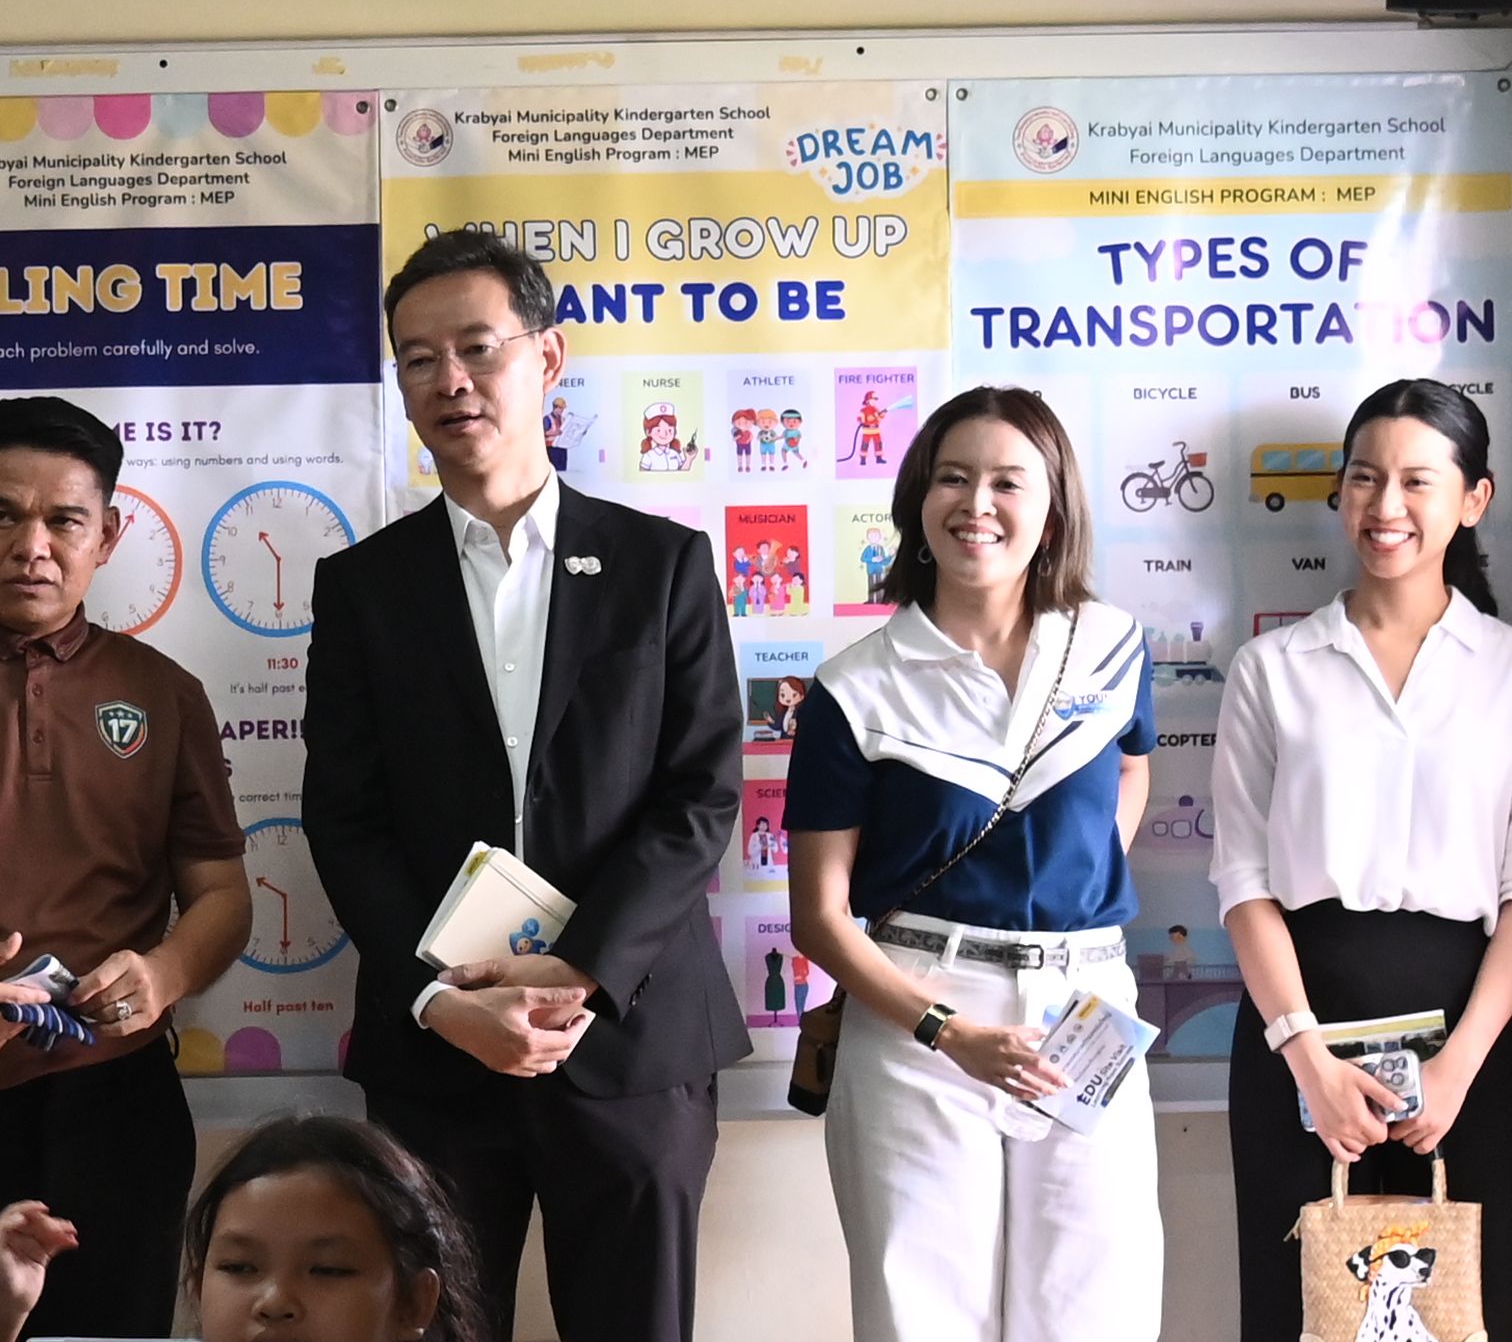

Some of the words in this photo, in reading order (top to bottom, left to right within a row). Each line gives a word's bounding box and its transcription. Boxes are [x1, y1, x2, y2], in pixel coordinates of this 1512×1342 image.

[455, 111, 511, 129] Krabyai
[517, 110, 609, 124] Municipality
[614, 109, 713, 123] Kindergarten
[720, 107, 769, 119] School
[492, 130, 549, 145] Foreign
[554, 130, 636, 144] Languages
[642, 128, 733, 142] Department
[1089, 123, 1152, 138] Krabyai
[1159, 121, 1262, 138] Municipality
[1269, 120, 1381, 137] Kindergarten
[1388, 117, 1445, 133] School
[798, 127, 934, 163] DREAM
[33, 155, 124, 169] Municipality
[131, 153, 230, 168] Kindergarten
[236, 152, 286, 164] School
[509, 149, 539, 161] Mini
[545, 148, 600, 164] English
[606, 148, 670, 162] Program
[685, 146, 718, 158] MEP
[1130, 149, 1193, 165] Foreign
[1200, 150, 1294, 166] Languages
[1301, 147, 1404, 163] Department
[9, 175, 65, 191] Foreign
[70, 175, 152, 189] Languages
[158, 172, 249, 186] Department
[831, 161, 904, 195] JOB
[24, 194, 55, 207] Mini
[61, 194, 116, 209] English
[122, 193, 186, 207] Program
[201, 191, 234, 204] MEP
[1089, 190, 1130, 205] MINI
[1136, 189, 1214, 204] ENGLISH
[1221, 188, 1315, 202] PROGRAM
[1337, 187, 1375, 201] MEP
[425, 219, 596, 263] HEN
[616, 219, 630, 261] I
[645, 216, 818, 261] GROW
[832, 214, 908, 258] UP
[1097, 237, 1269, 284] TYPES
[1290, 239, 1369, 281] OF
[156, 262, 304, 312] TIME
[556, 283, 664, 324] ANT
[681, 282, 758, 323] TO
[778, 281, 846, 320] BE
[971, 300, 1495, 349] TRANSPORTATION
[31, 342, 97, 362] problem
[103, 339, 172, 359] carefully
[177, 339, 208, 355] and
[215, 339, 259, 354] solve.
[643, 378, 680, 387] NURSE
[743, 375, 795, 386] ATHLETE
[839, 375, 861, 383] FIRE
[866, 374, 914, 383] FIGHTER
[1134, 388, 1197, 399] BICYCLE
[1290, 387, 1320, 399] BUS
[146, 422, 172, 441] IS
[182, 421, 220, 441] IT?
[161, 457, 191, 469] using
[195, 455, 243, 467] numbers
[246, 455, 268, 465] and
[273, 455, 303, 467] using
[307, 452, 343, 463] words.
[739, 514, 795, 524] MUSICIAN
[852, 513, 891, 523] ACTOR
[1144, 559, 1192, 571] TRAIN
[1292, 558, 1325, 570] VAN
[267, 658, 298, 669] 11:30
[756, 652, 808, 662] TEACHER
[107, 719, 137, 744] 17
[244, 1000, 271, 1012] Half
[277, 1002, 307, 1015] past
[312, 1001, 333, 1011] ten
